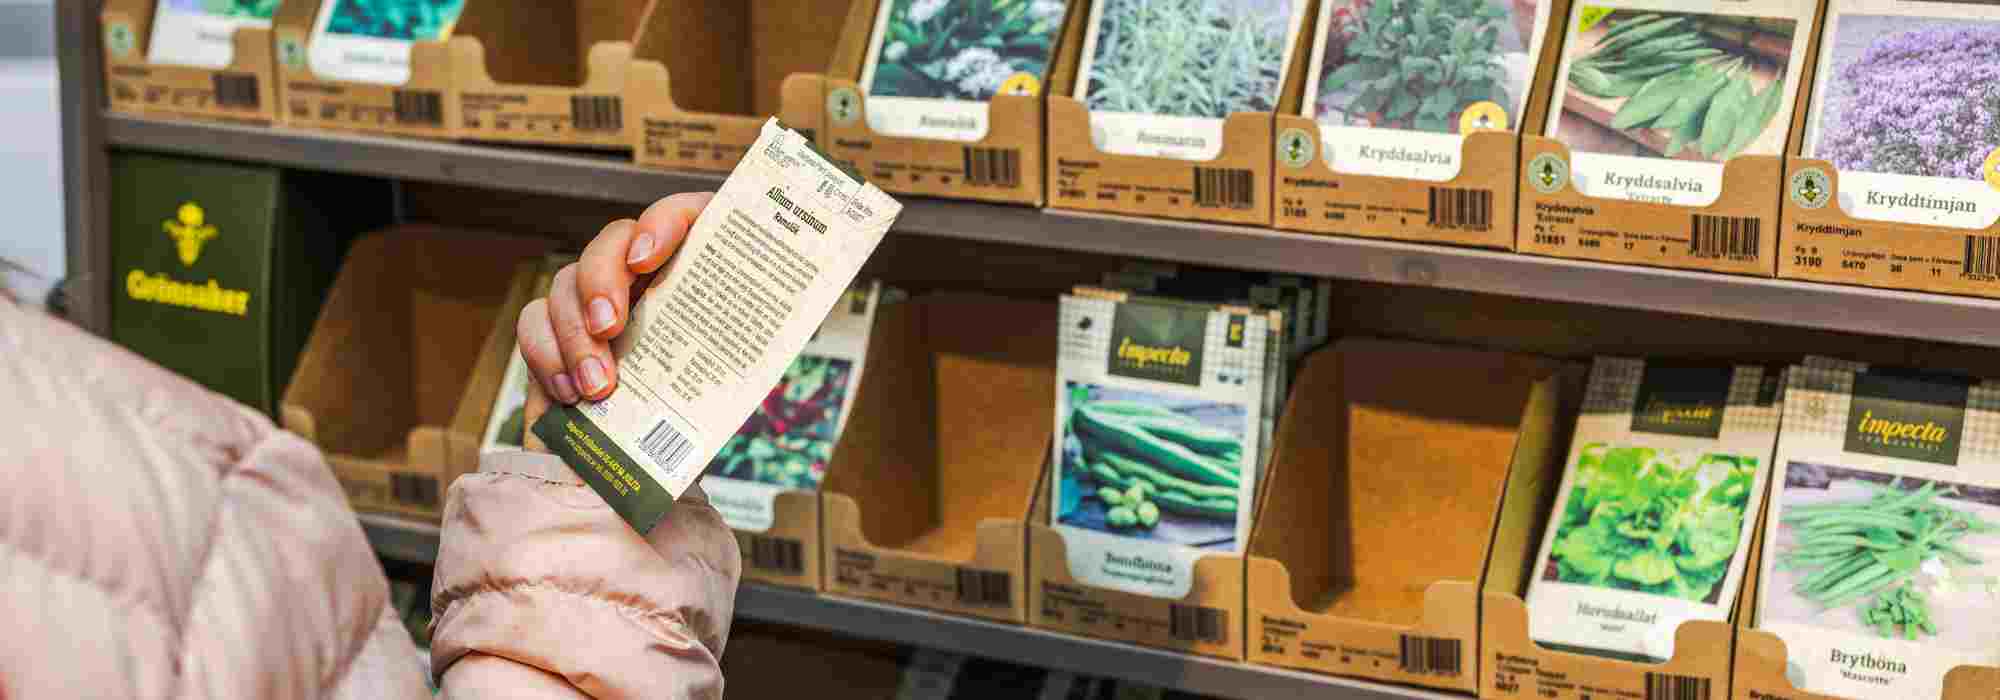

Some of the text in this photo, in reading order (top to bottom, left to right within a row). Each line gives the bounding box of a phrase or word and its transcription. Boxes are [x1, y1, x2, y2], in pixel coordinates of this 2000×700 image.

[1359, 144, 1452, 166] Kryddsalvia
[1603, 170, 1703, 195] Kryddsalvia
[1866, 189, 1977, 215] Kryddtimjan
[791, 204, 829, 234] ursinum
[1795, 222, 1862, 239] Kryddtimjan
[1829, 647, 1907, 674] Brytböna
